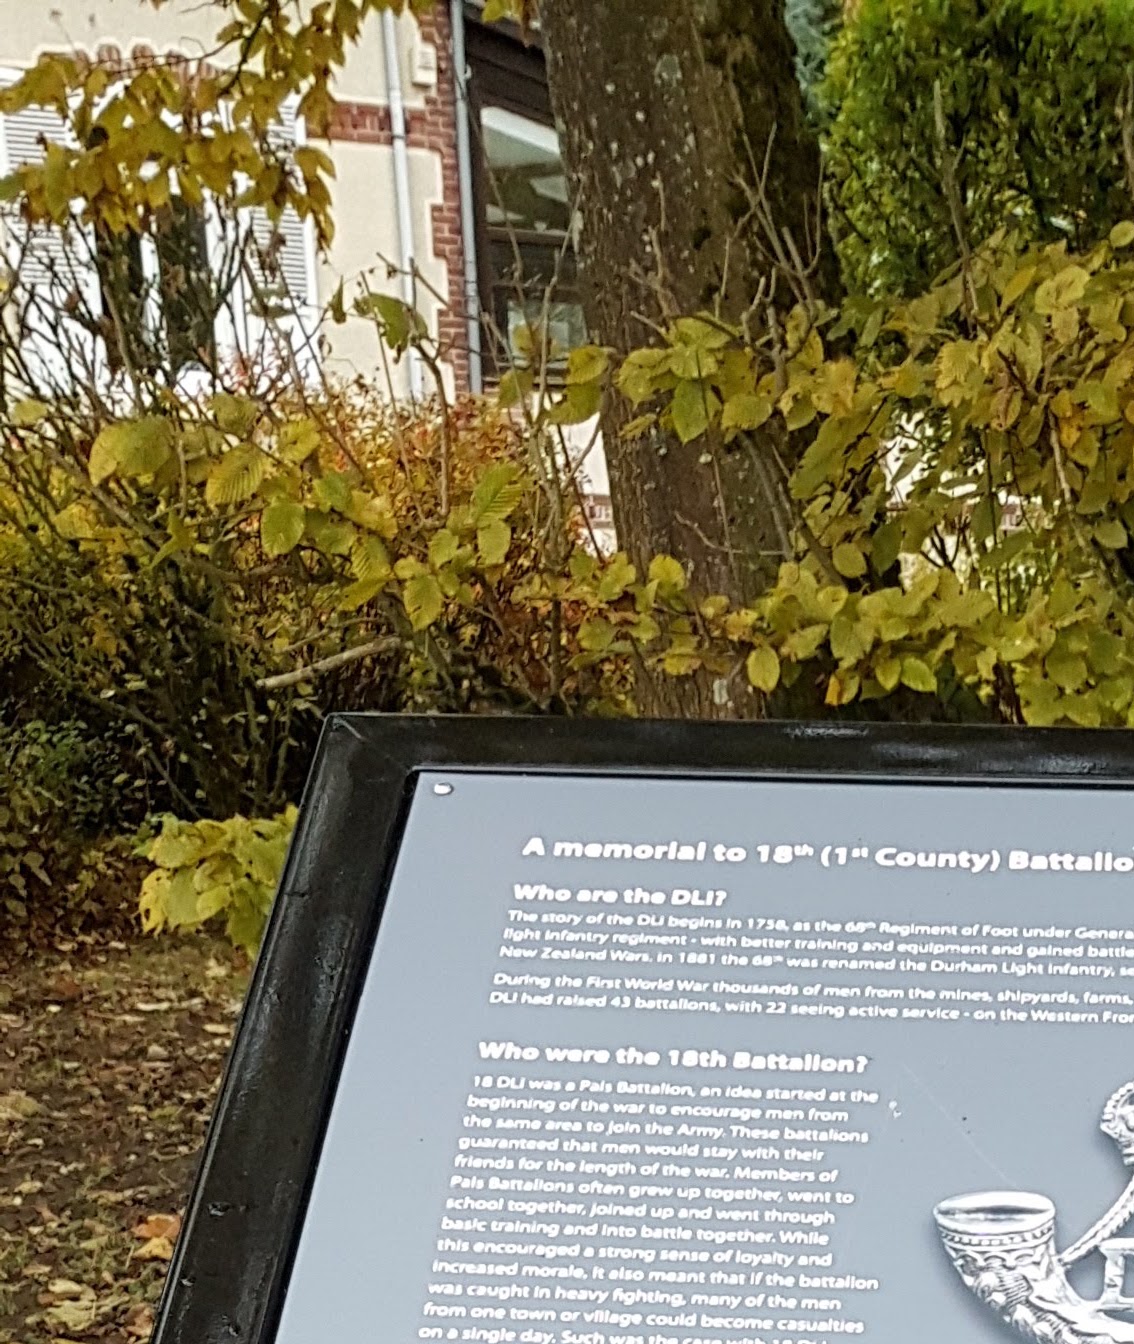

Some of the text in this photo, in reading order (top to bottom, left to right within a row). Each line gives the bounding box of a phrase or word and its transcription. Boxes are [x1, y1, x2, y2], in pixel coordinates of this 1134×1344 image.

[522, 837, 545, 856] A
[553, 841, 706, 860] memorial
[713, 844, 747, 862] to
[875, 847, 1000, 873] County)
[514, 884, 727, 906] Who are the DLI?
[503, 928, 541, 942] light
[544, 929, 609, 945] infantry
[612, 933, 687, 946] regiment
[700, 935, 737, 947] with
[740, 936, 791, 949] better
[794, 938, 859, 953] training
[862, 940, 894, 952] and
[897, 942, 988, 955] equipment
[991, 943, 1023, 956] and
[1026, 945, 1084, 958] gained
[479, 1041, 868, 1073] Who were the 18th Battalion?
[467, 1094, 849, 1122] beginning of the war to encourage men from
[459, 1137, 824, 1161] guaranteed that men would stay with their
[450, 1175, 484, 1190] Pals
[488, 1176, 574, 1193] Battalions
[578, 1180, 625, 1195] often
[628, 1185, 674, 1198] grew
[676, 1187, 701, 1201] up
[787, 1191, 831, 1203] went
[835, 1192, 855, 1204] to
